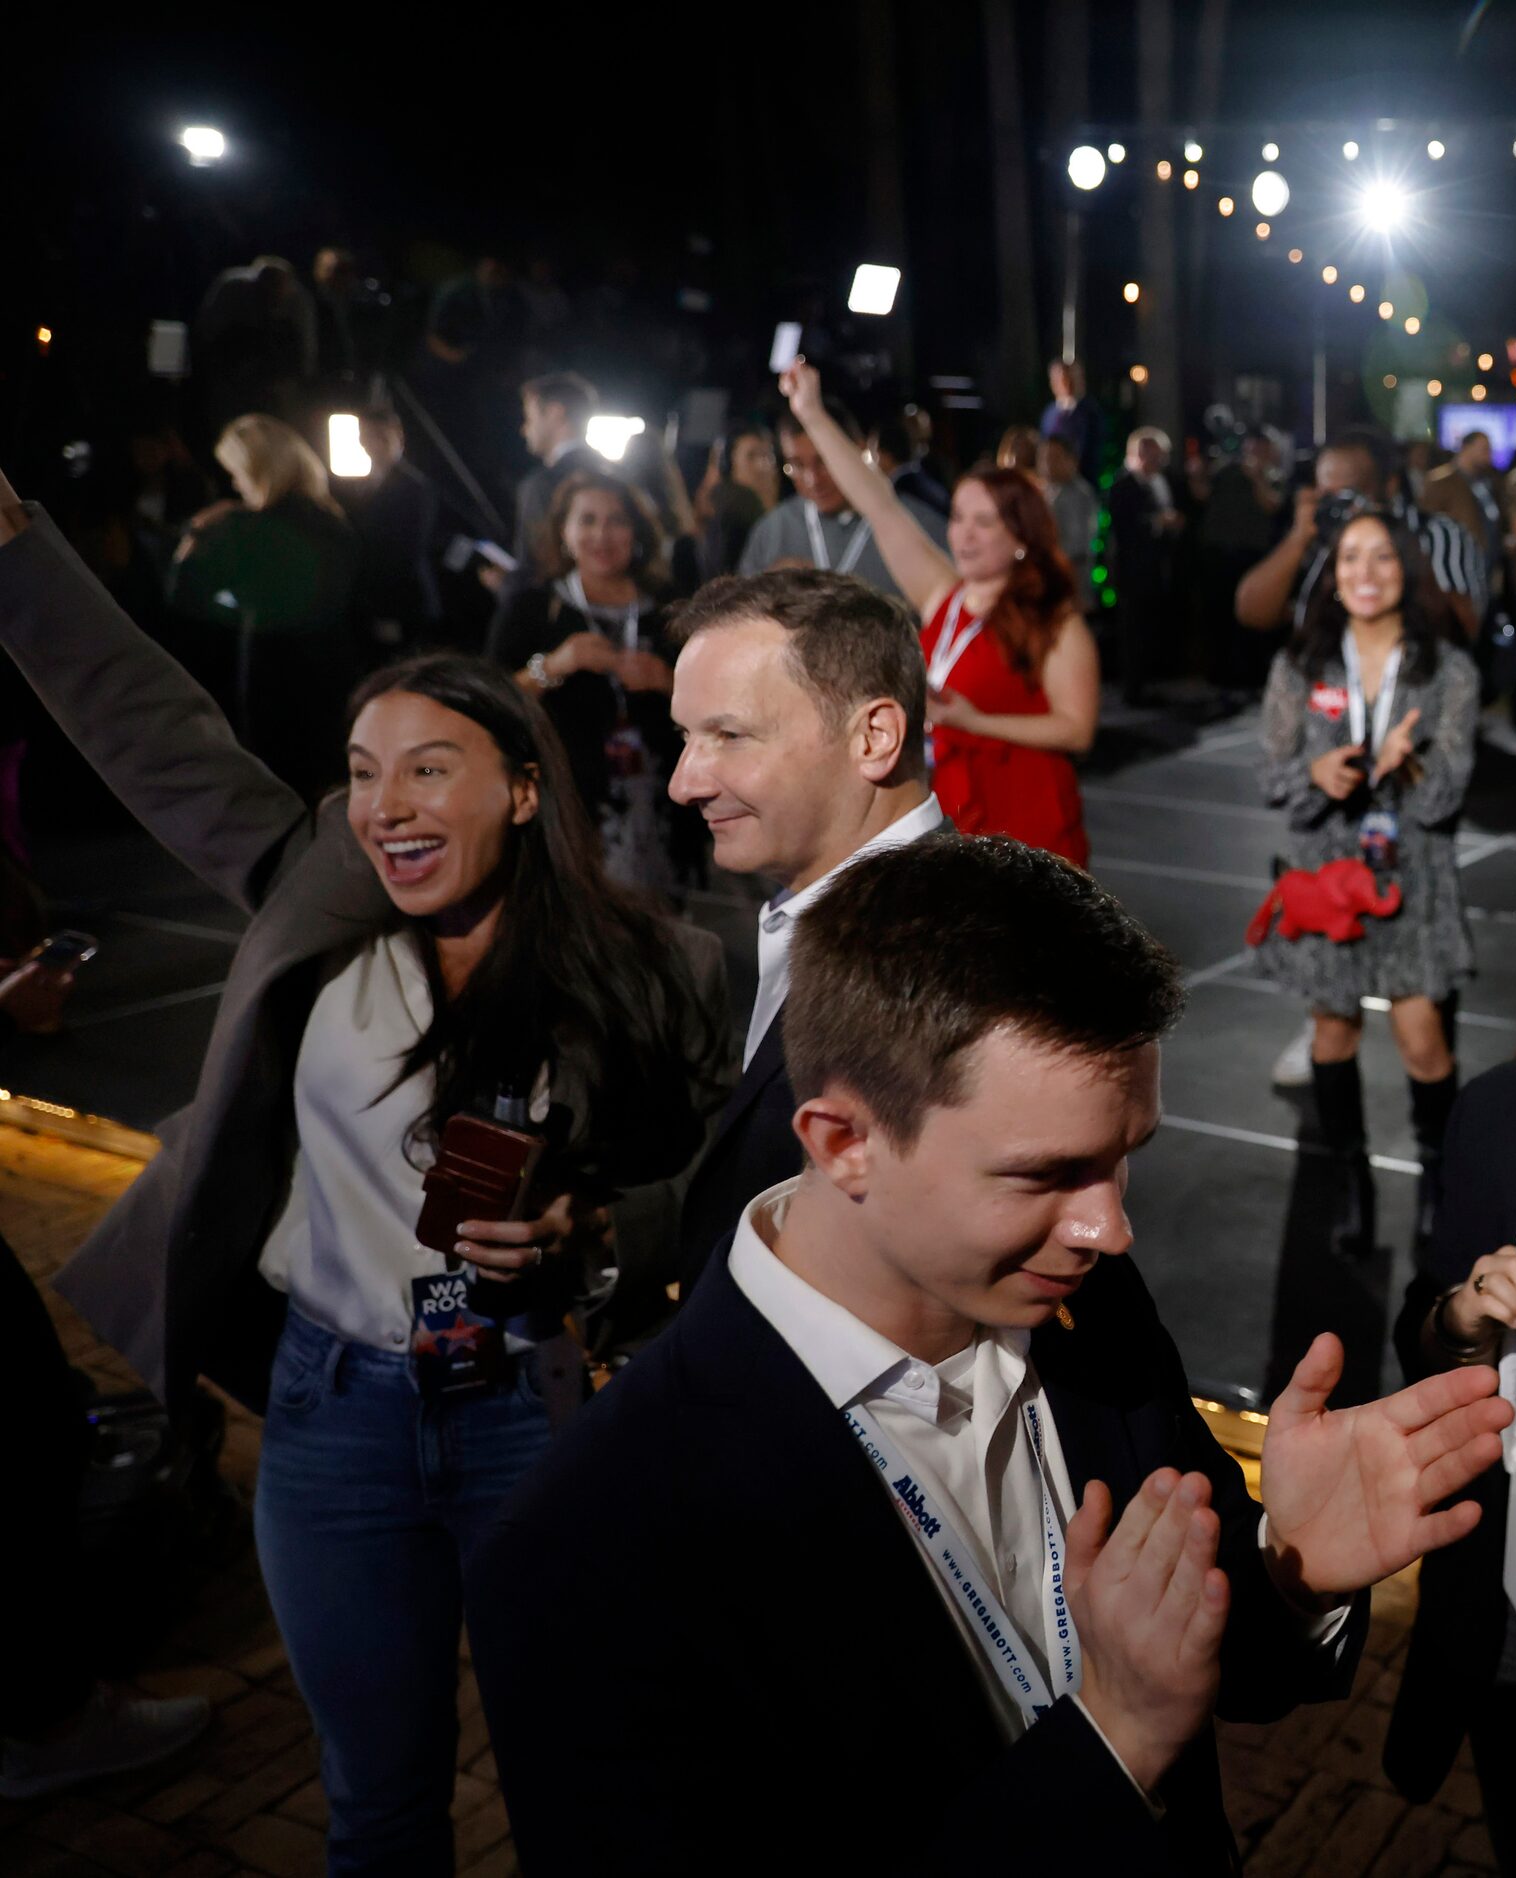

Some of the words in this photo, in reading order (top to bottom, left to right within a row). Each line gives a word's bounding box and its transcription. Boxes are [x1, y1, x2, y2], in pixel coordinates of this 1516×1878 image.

[428, 1280, 467, 1299] WA
[892, 1474, 941, 1539] Abbott
[942, 1549, 1032, 1693] www.GREGABBOTT.com
